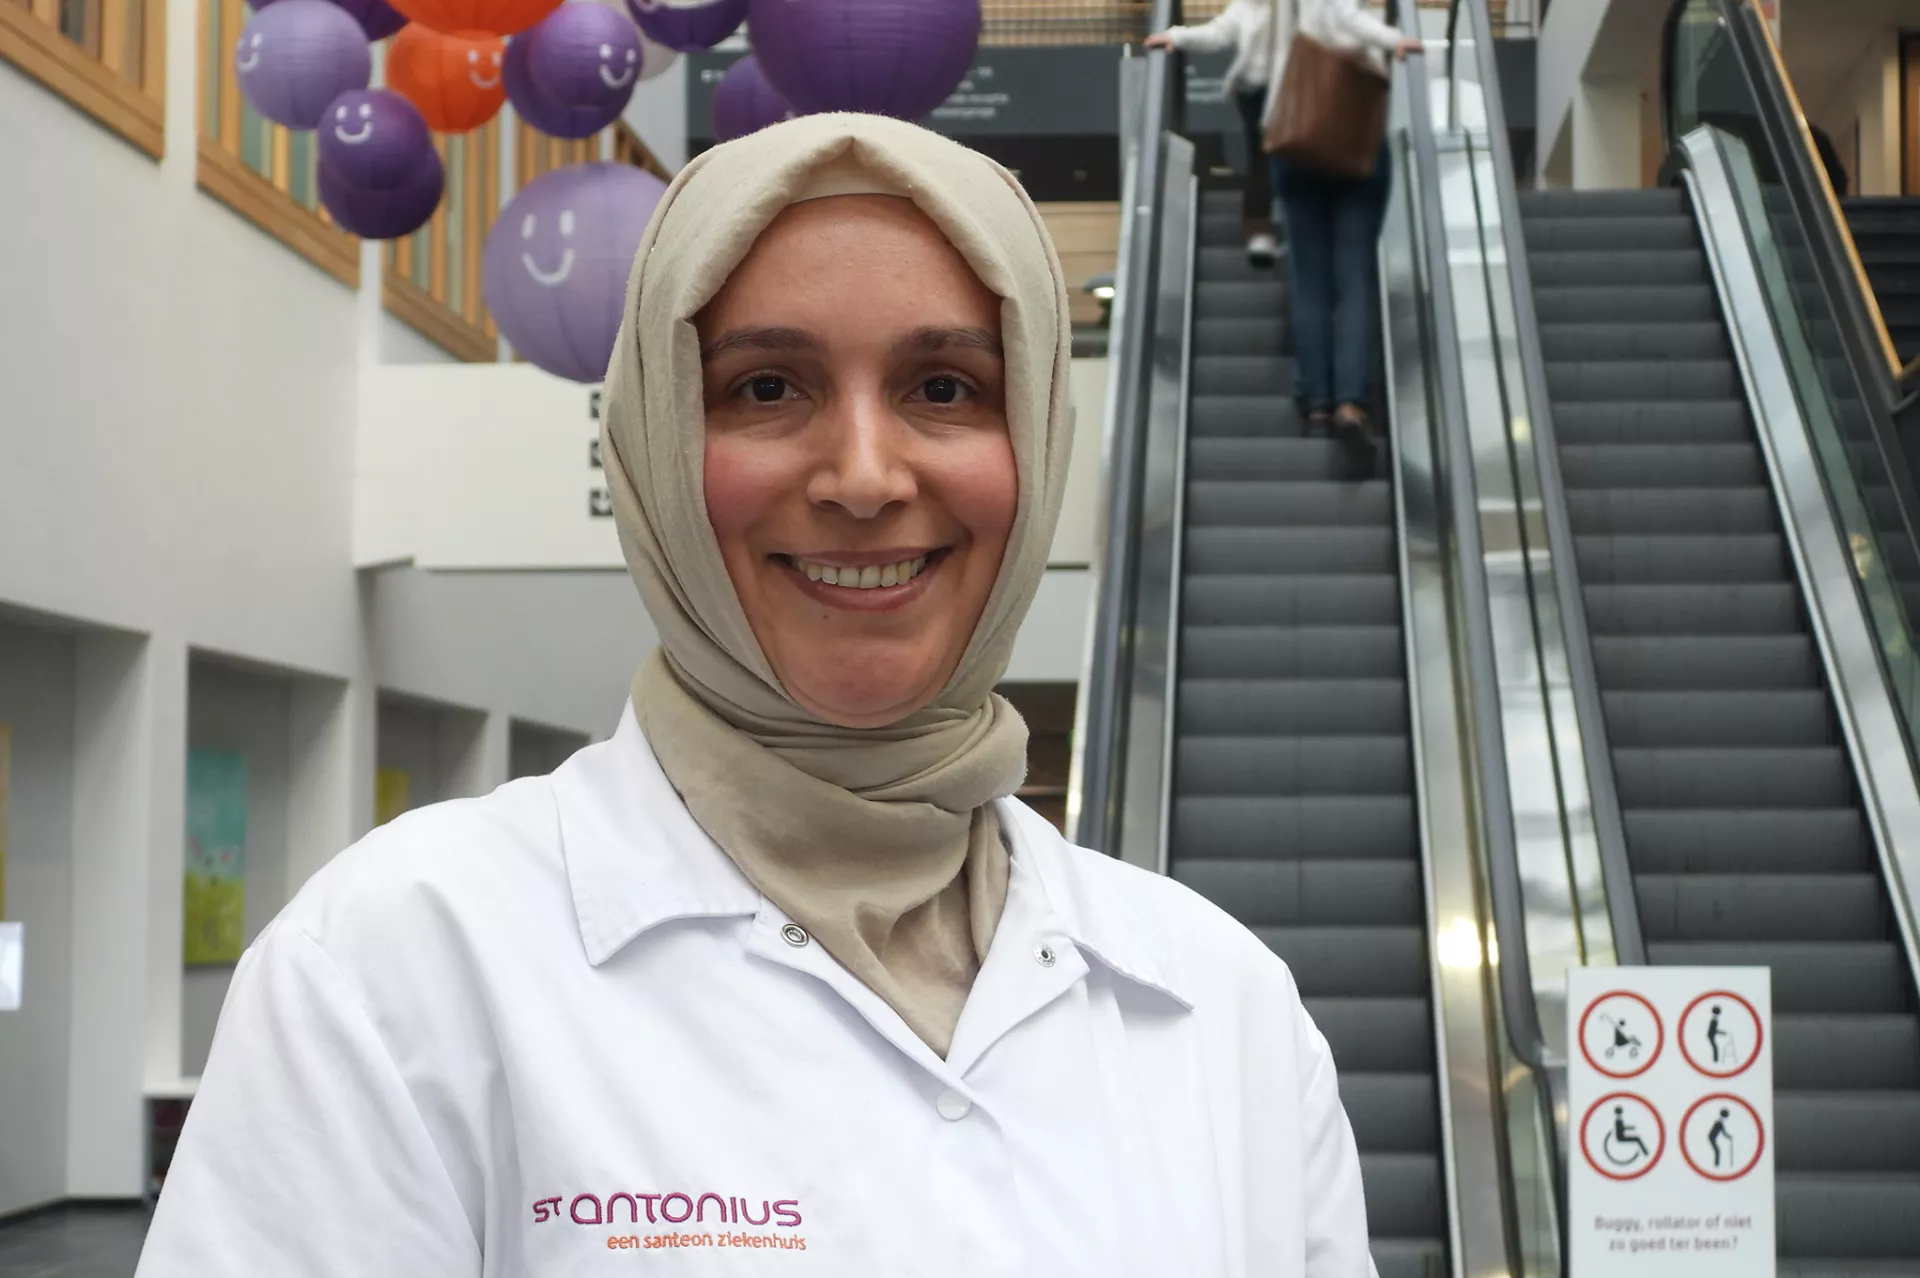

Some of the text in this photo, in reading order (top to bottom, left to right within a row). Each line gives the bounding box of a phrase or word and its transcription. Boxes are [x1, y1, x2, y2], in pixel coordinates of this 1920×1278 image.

[1649, 1215, 1701, 1229] rollator
[1705, 1214, 1721, 1229] of
[1724, 1215, 1752, 1229] niet
[607, 1231, 807, 1250] een santeon ziekenhuis
[1609, 1236, 1738, 1254] zo goed ter been?
